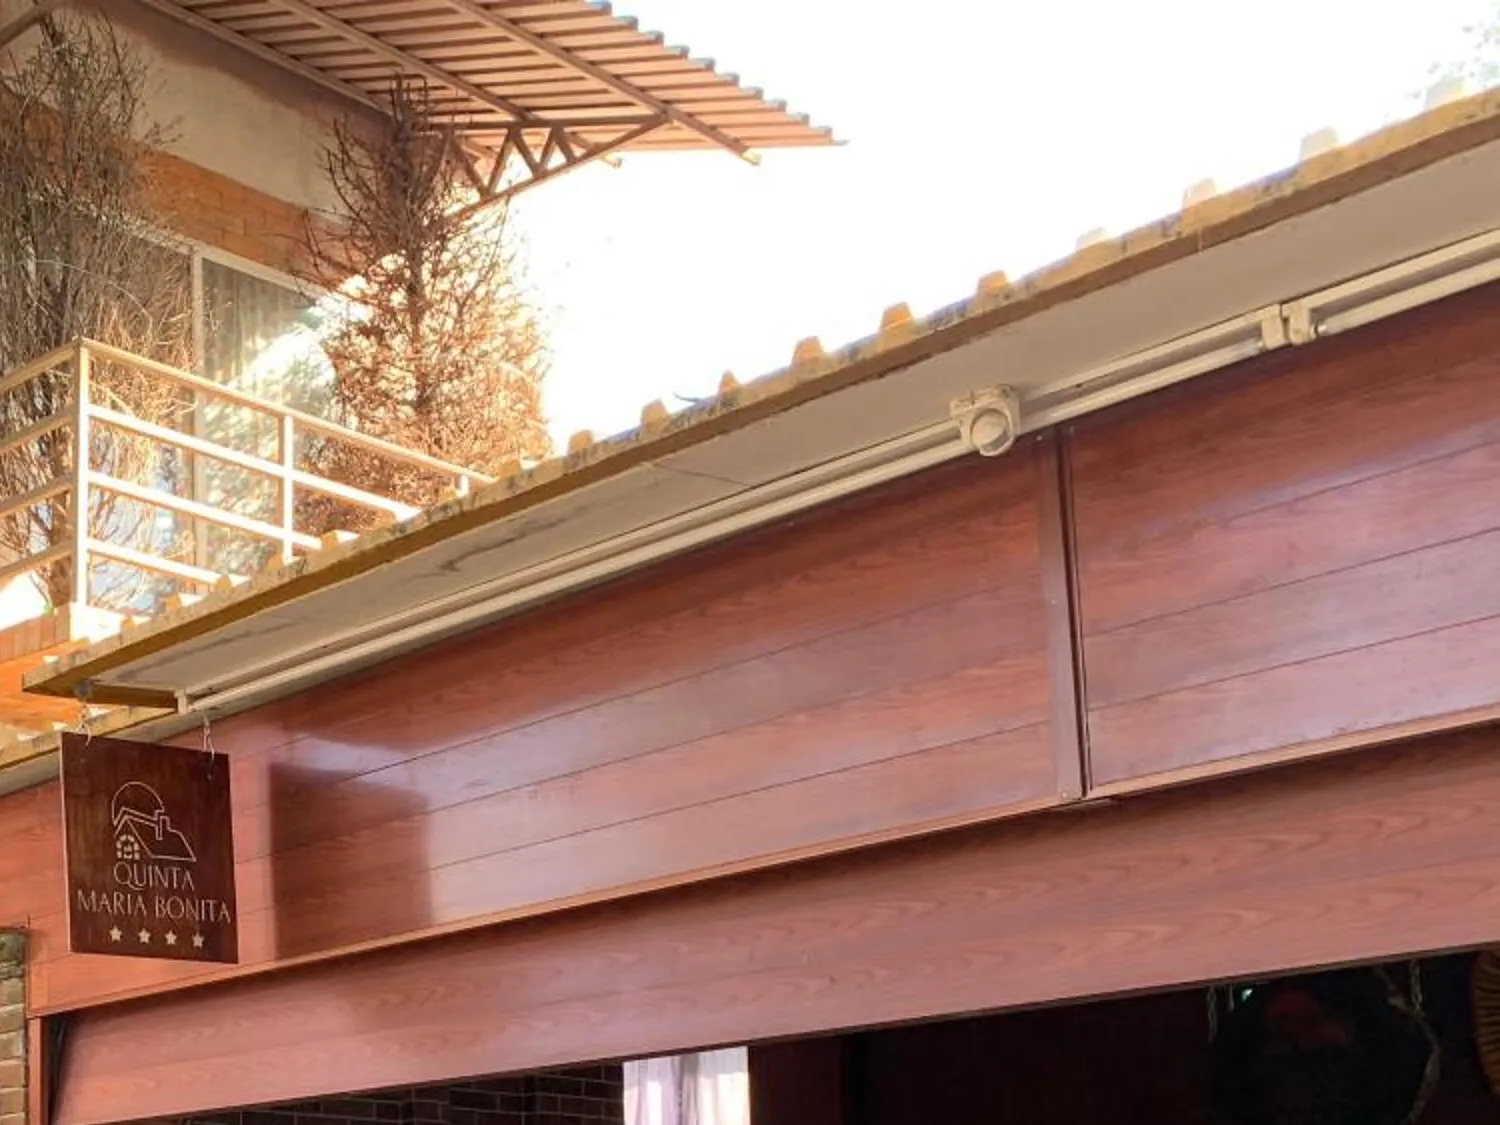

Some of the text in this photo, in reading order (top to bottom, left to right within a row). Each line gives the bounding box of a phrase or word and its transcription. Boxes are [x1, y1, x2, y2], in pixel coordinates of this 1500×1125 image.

[113, 861, 195, 891] QUINTA
[77, 888, 231, 924] MARIA BONITA
